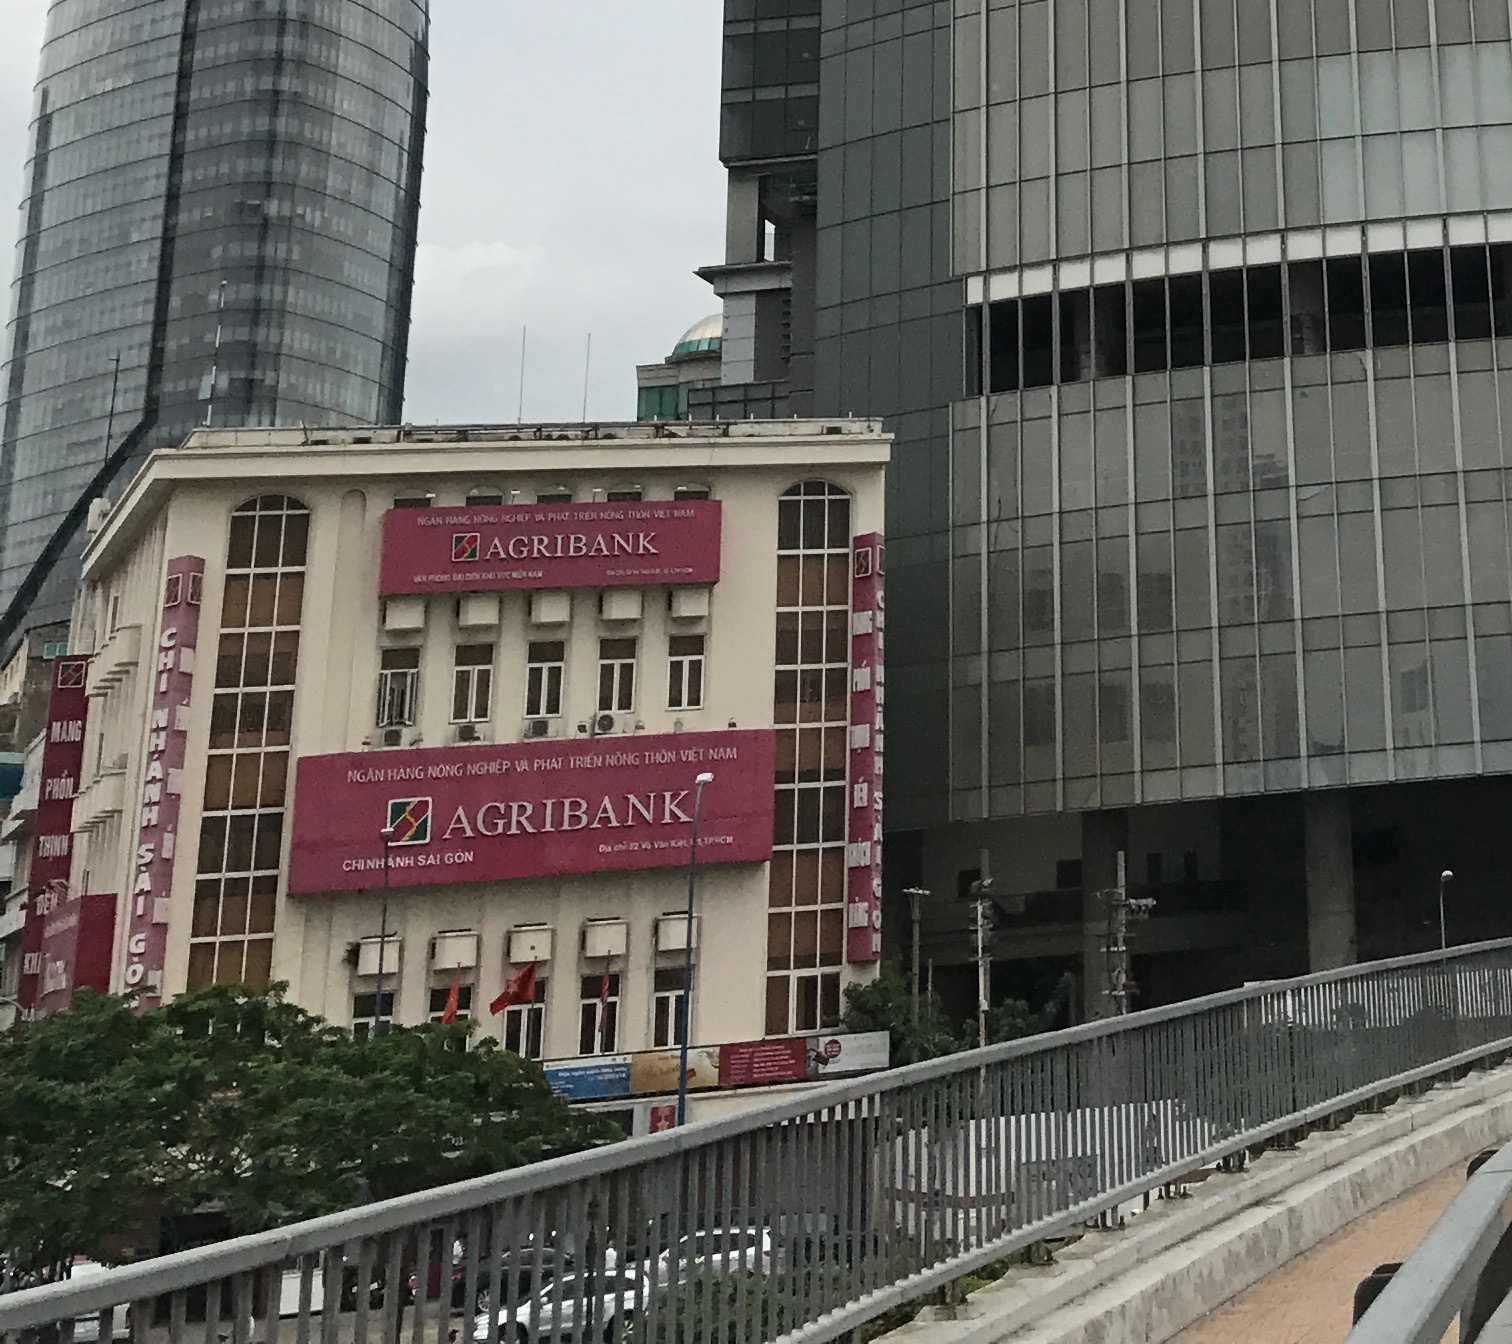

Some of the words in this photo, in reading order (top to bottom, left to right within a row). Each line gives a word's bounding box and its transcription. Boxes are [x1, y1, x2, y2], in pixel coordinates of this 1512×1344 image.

[484, 532, 660, 561] AGRIBANK
[158, 627, 178, 693] CHI
[708, 746, 738, 761] NAM
[442, 790, 694, 840] AGRIBANK
[341, 859, 365, 872] CHI
[417, 850, 441, 867] SÀI
[444, 848, 474, 865] GÒN
